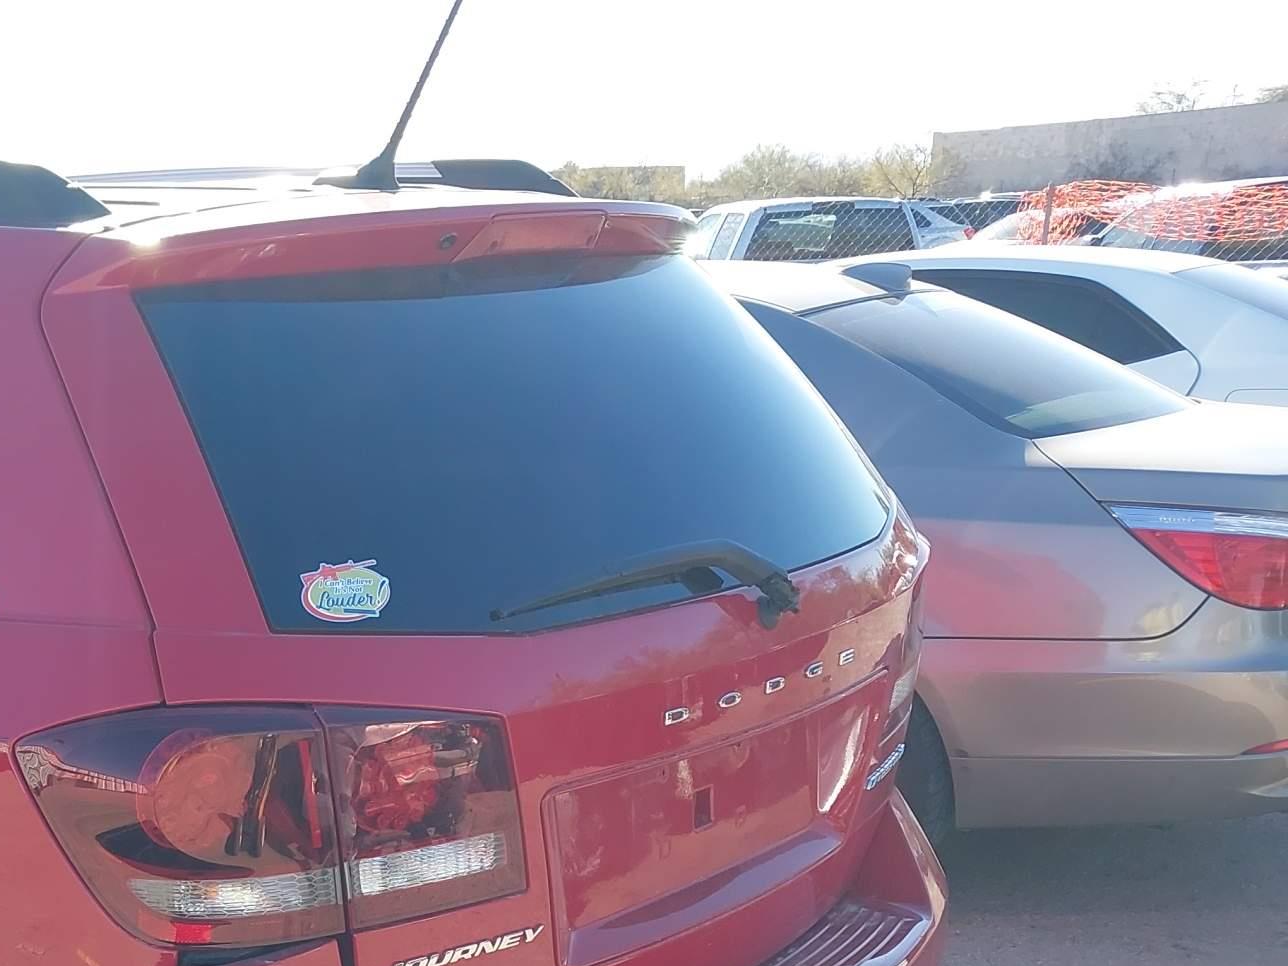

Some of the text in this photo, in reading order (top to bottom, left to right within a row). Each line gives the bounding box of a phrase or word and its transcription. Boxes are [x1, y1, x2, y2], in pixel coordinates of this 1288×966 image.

[324, 579, 345, 587] Can't
[346, 578, 373, 586] Believe
[348, 586, 363, 594] Not
[665, 648, 855, 726] DODGE
